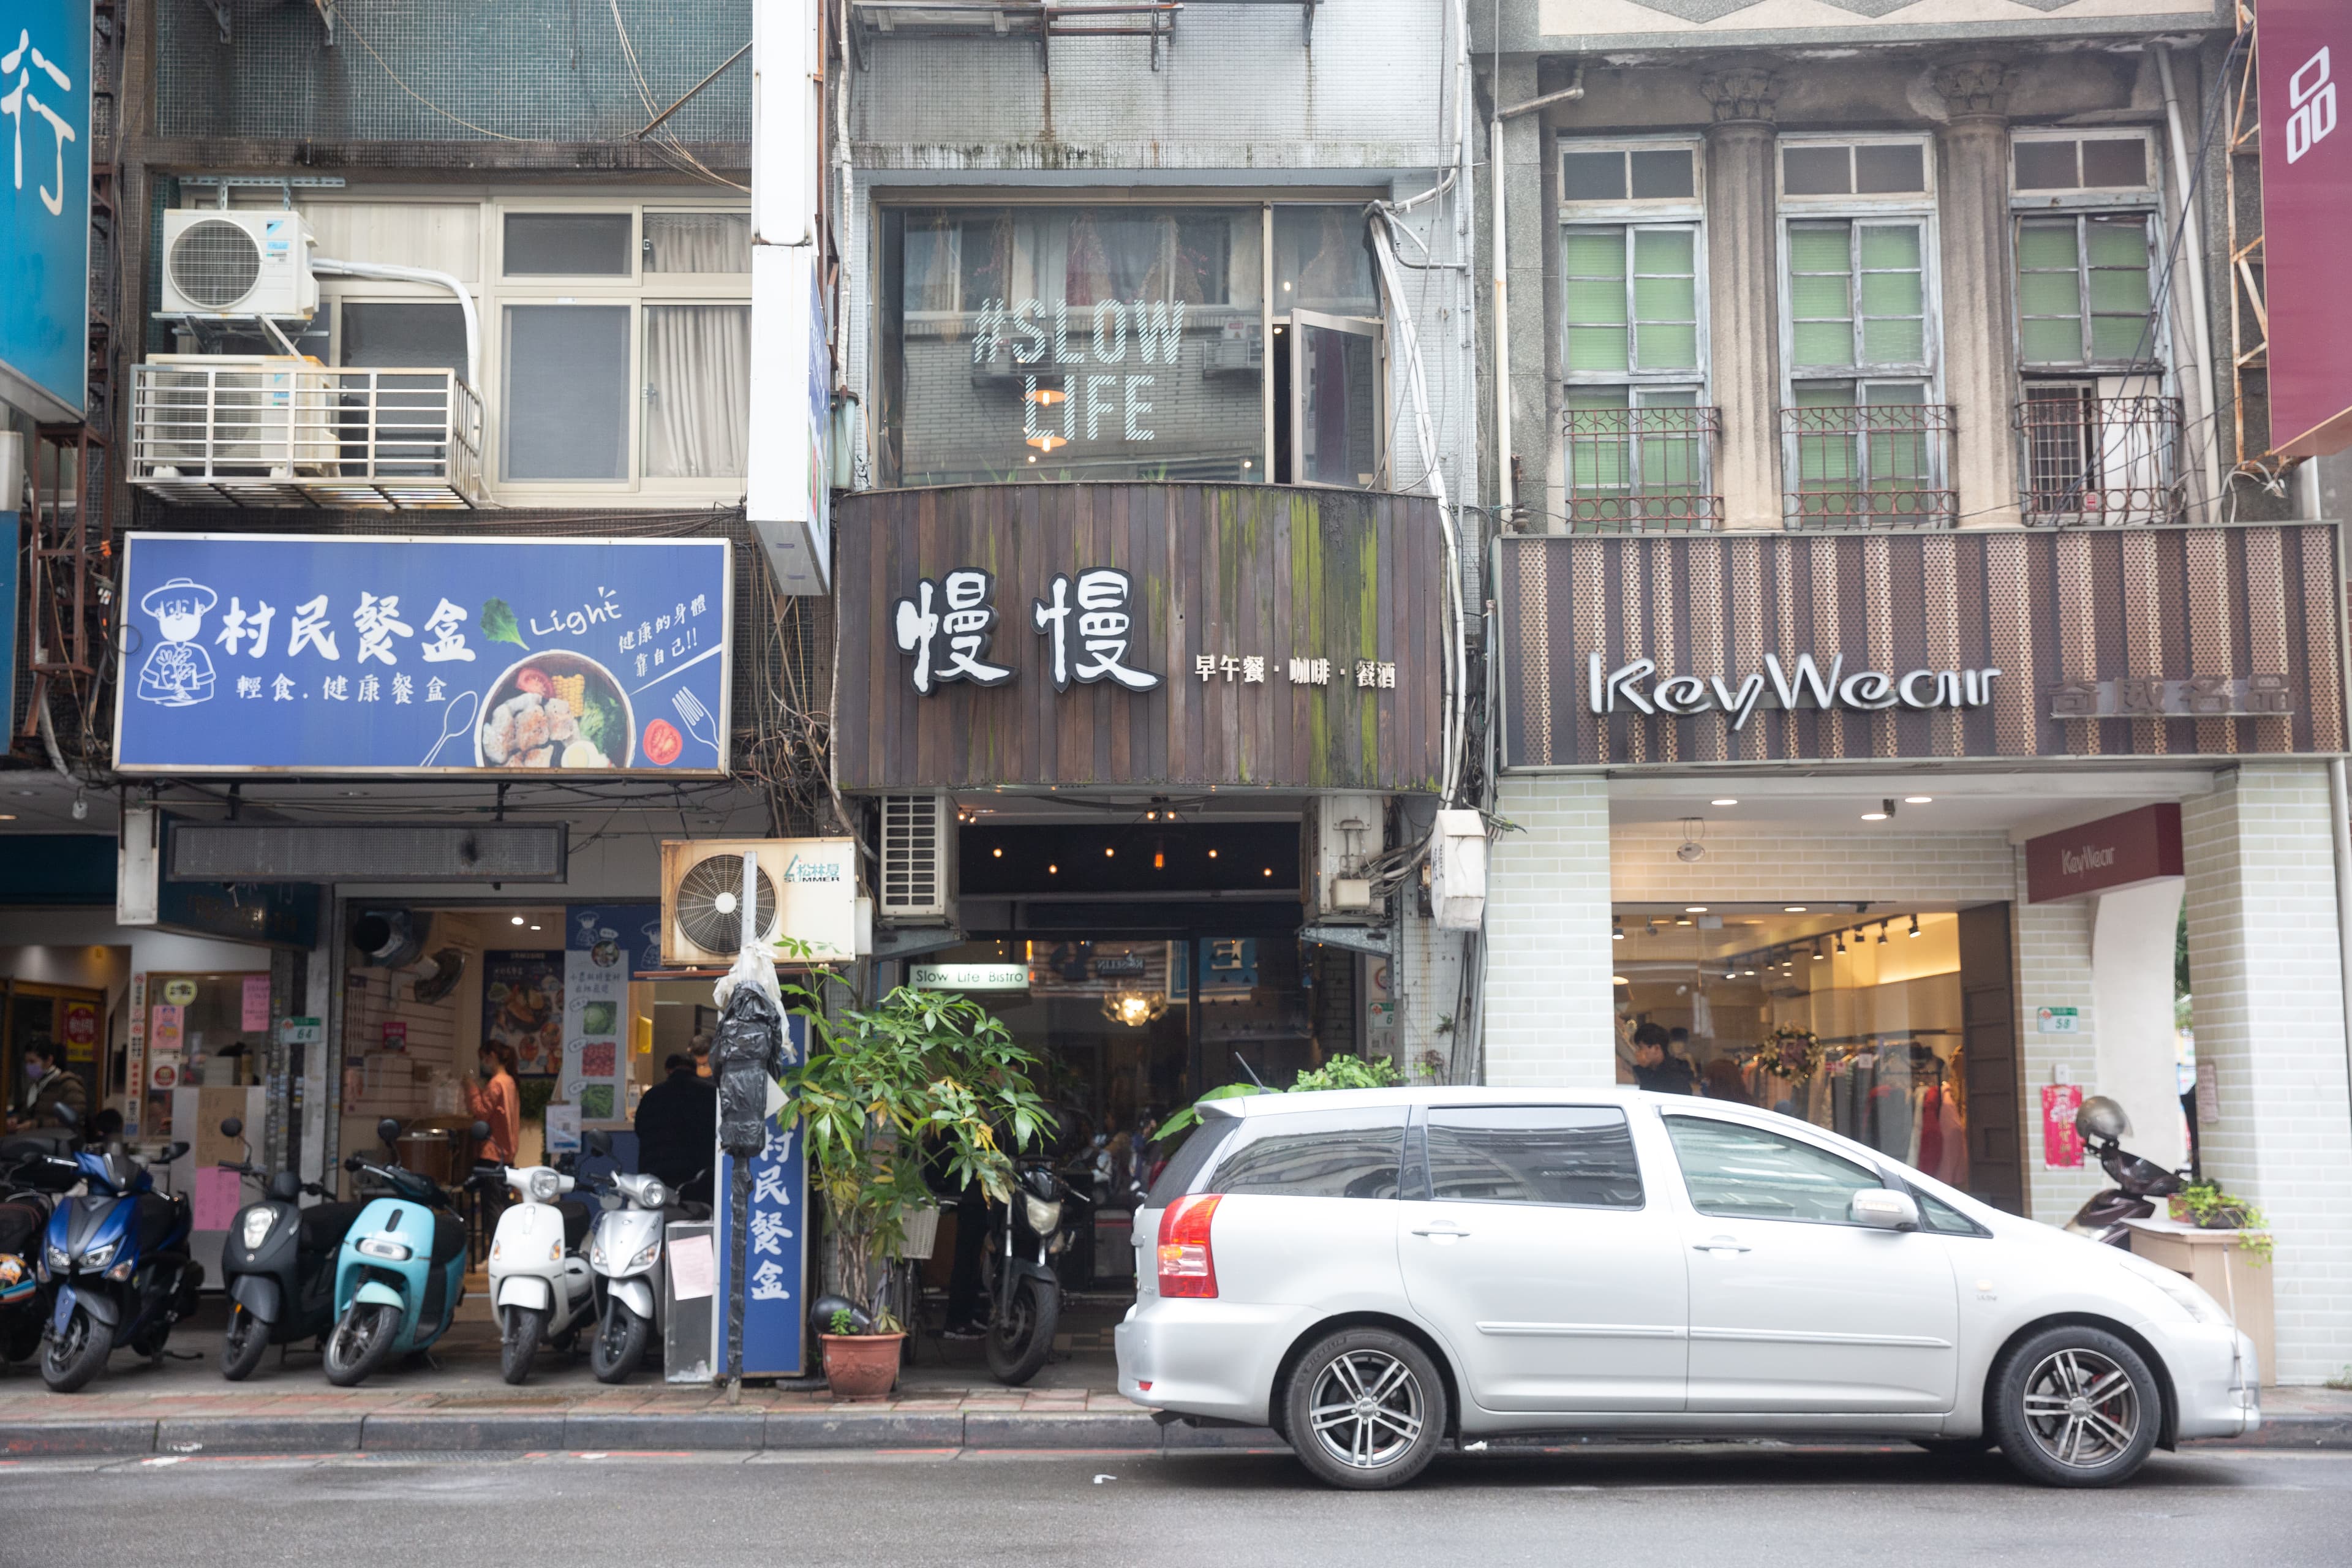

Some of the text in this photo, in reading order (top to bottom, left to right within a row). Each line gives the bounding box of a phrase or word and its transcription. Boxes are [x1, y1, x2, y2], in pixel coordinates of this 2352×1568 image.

[1, 28, 76, 216] 行
[972, 298, 1186, 365] #SLOW
[1025, 375, 1156, 442] LIFE
[214, 591, 476, 665] 村民餐盒
[530, 592, 622, 637] Light
[619, 594, 706, 654] 健康的身體
[895, 568, 1165, 694] 慢慢
[1590, 650, 2002, 731] KeyWear
[2047, 674, 2296, 714] 奇威名品
[2062, 845, 2116, 878] KeyWear
[915, 970, 1023, 983] Slow Life Bistro
[750, 1126, 794, 1301] 村民餐盒
